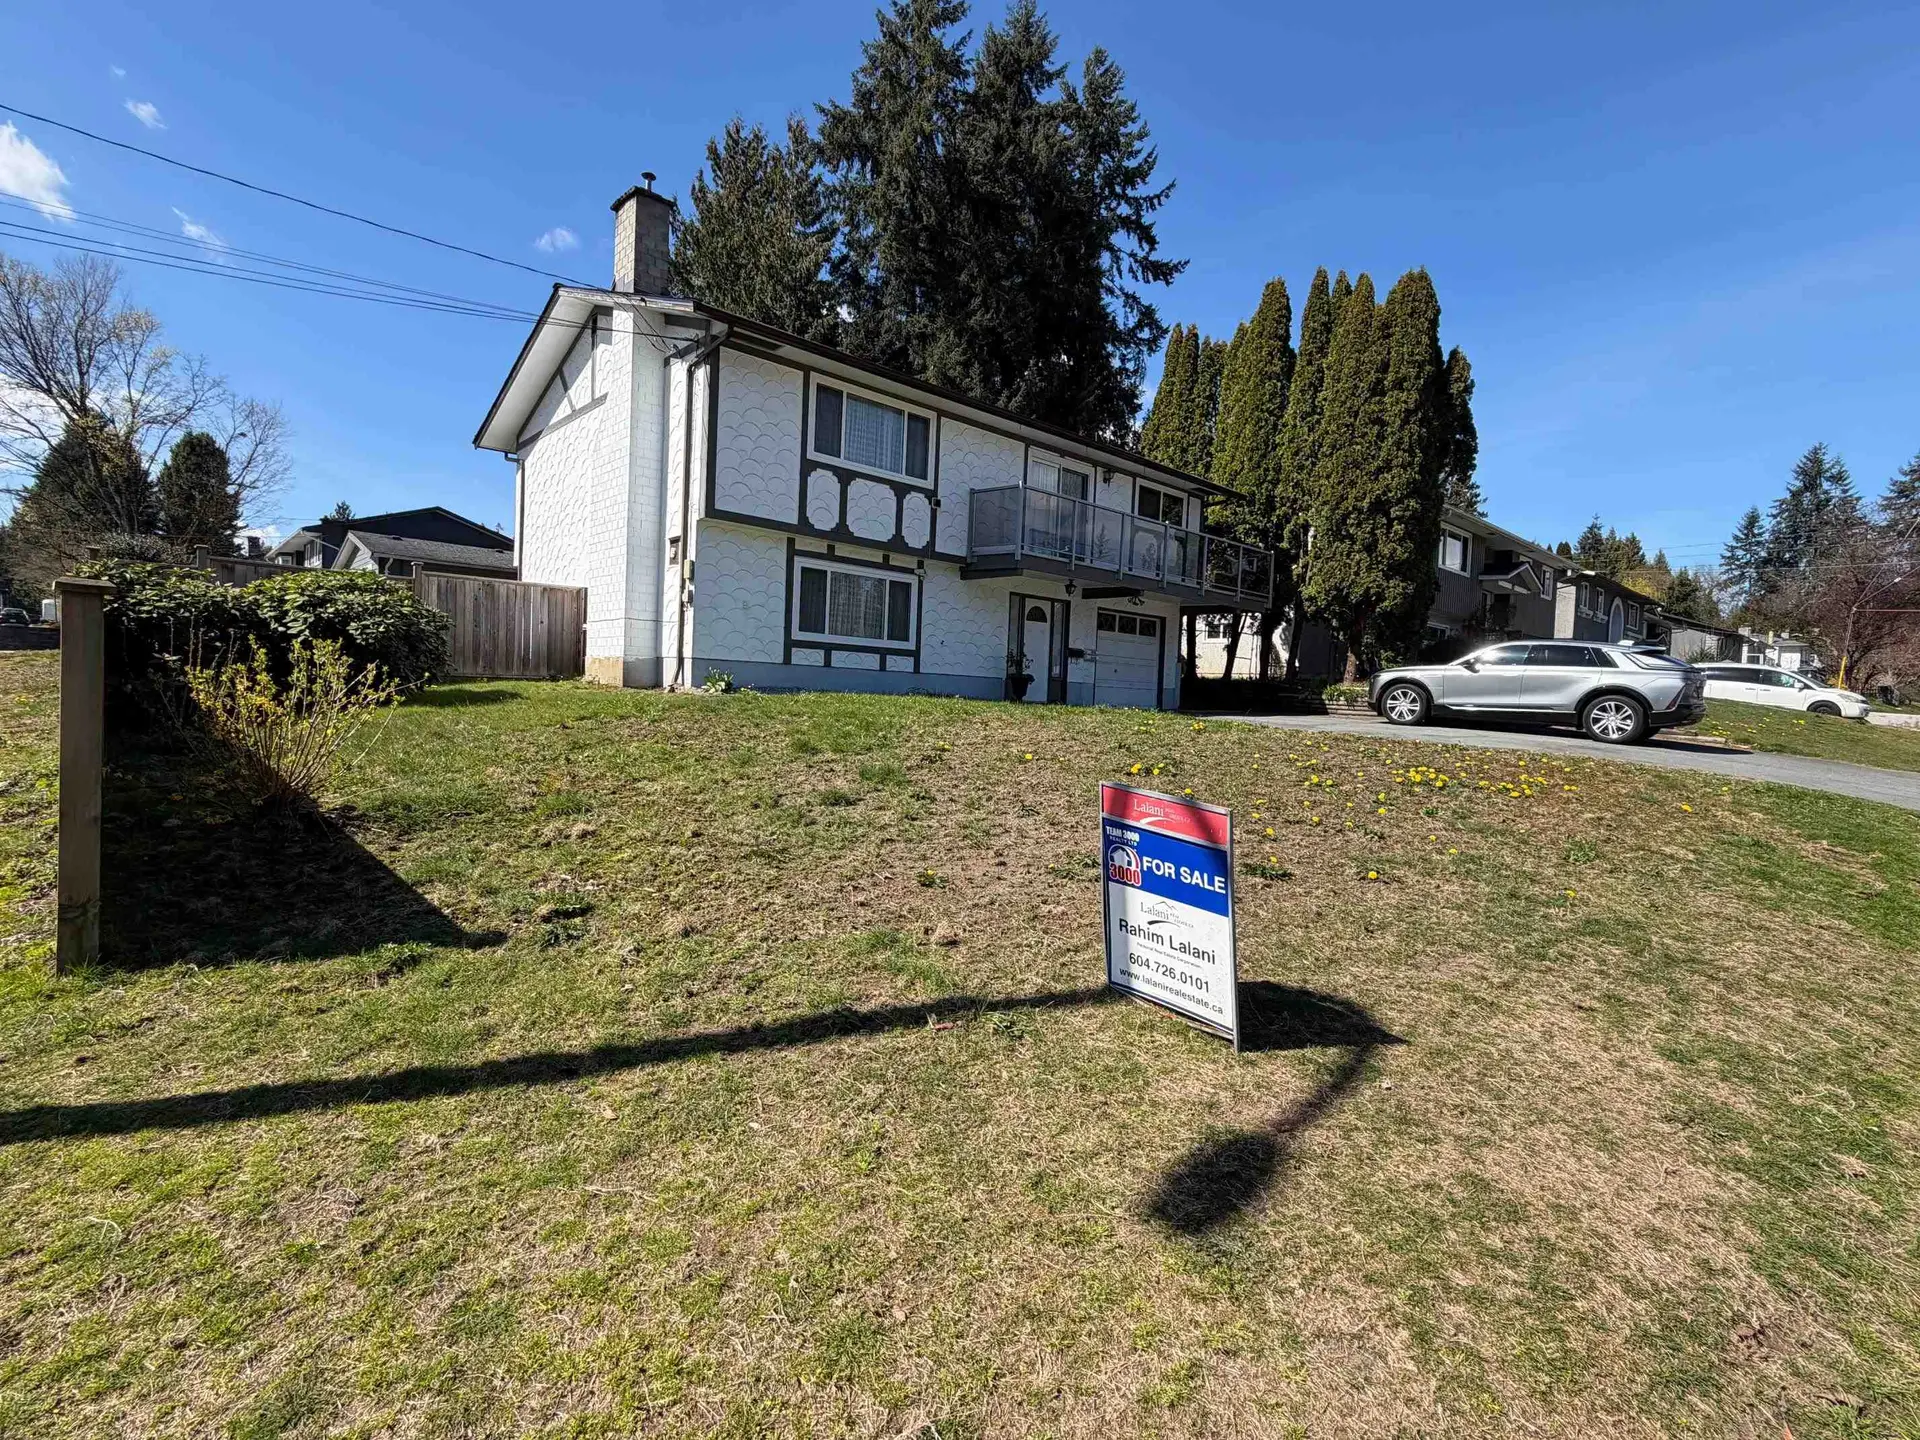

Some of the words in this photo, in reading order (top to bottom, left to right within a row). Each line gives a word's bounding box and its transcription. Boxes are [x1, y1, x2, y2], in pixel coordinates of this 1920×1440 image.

[1133, 799, 1164, 816] Lalani
[1106, 826, 1122, 836] TEAM
[1122, 829, 1140, 842] 3000
[1109, 861, 1142, 887] 3000
[1142, 856, 1176, 880] FOR
[1180, 866, 1227, 895] SALE
[1140, 901, 1170, 920] Lalani
[1119, 917, 1164, 946] Rahim
[1169, 934, 1216, 965] Lalani
[1129, 952, 1210, 993] 604.726.0101
[1119, 967, 1224, 1015] www.lalanirealestate.ca
